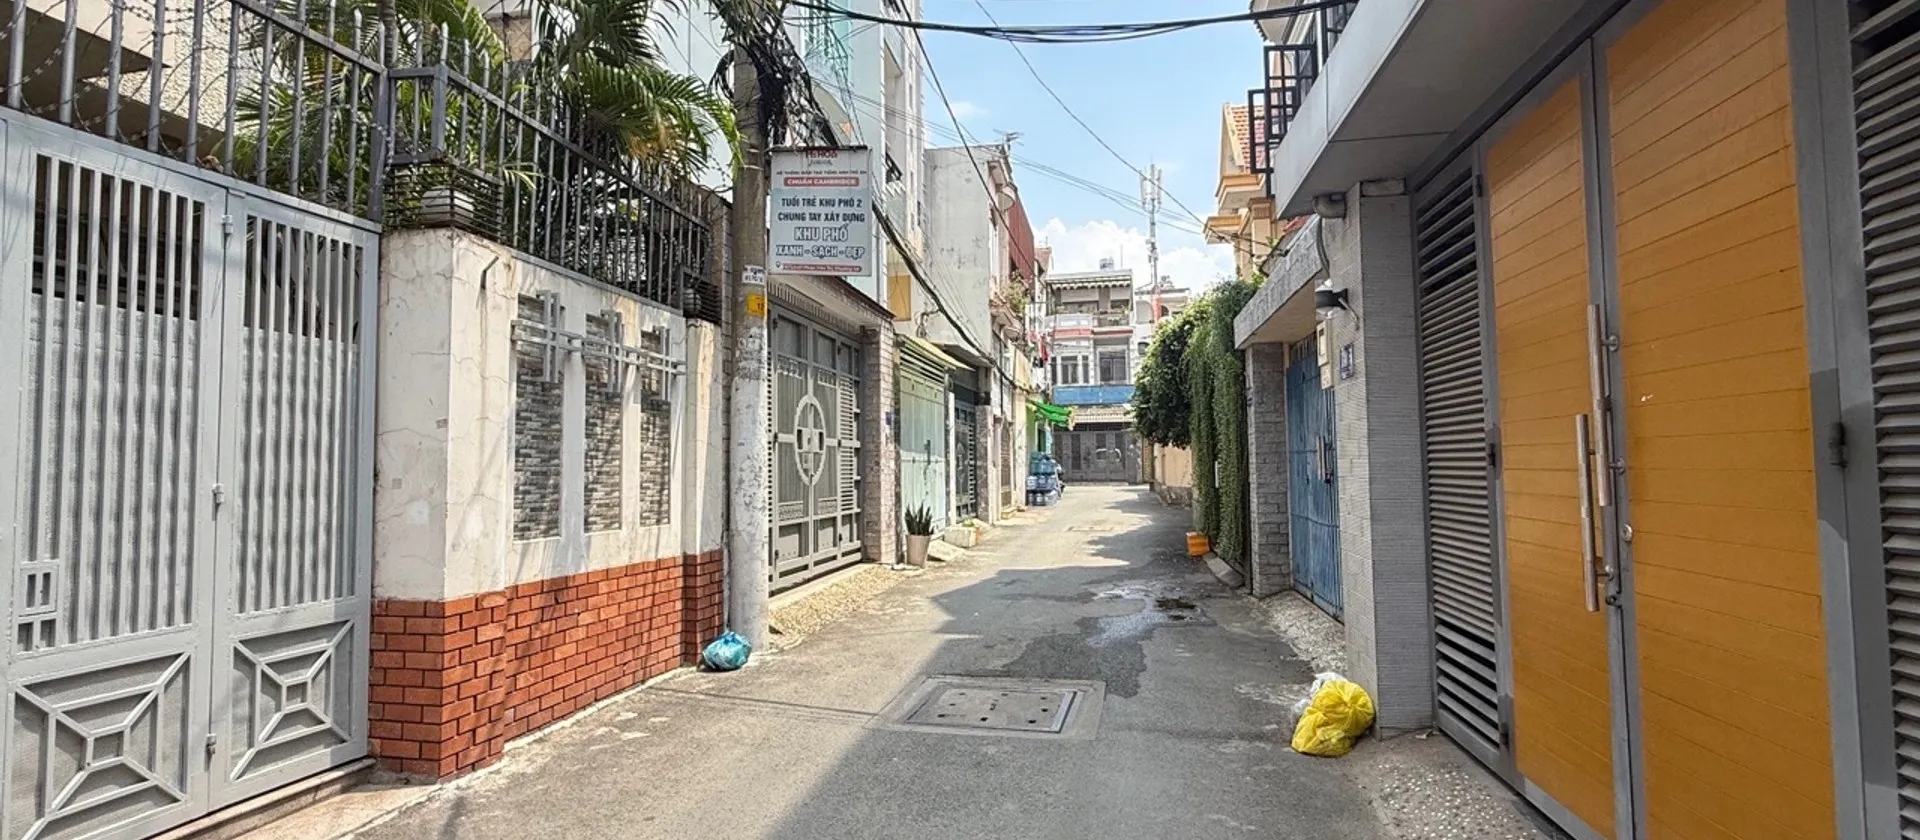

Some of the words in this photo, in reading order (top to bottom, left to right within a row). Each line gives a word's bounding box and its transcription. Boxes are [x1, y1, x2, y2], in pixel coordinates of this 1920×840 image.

[813, 178, 857, 186] CAMBRIDGE
[801, 195, 817, 208] TRẺ
[819, 198, 836, 208] KHU
[856, 199, 863, 208] 2
[777, 212, 807, 222] CHUNG
[808, 212, 822, 222] TAY
[823, 211, 840, 222] XÂY
[842, 212, 866, 224] DỰNG
[794, 226, 820, 241] KHU
[822, 223, 849, 242] PHỐ
[776, 244, 804, 257] XANH
[811, 244, 838, 259] SẠCH
[845, 246, 866, 260] ĐẸP
